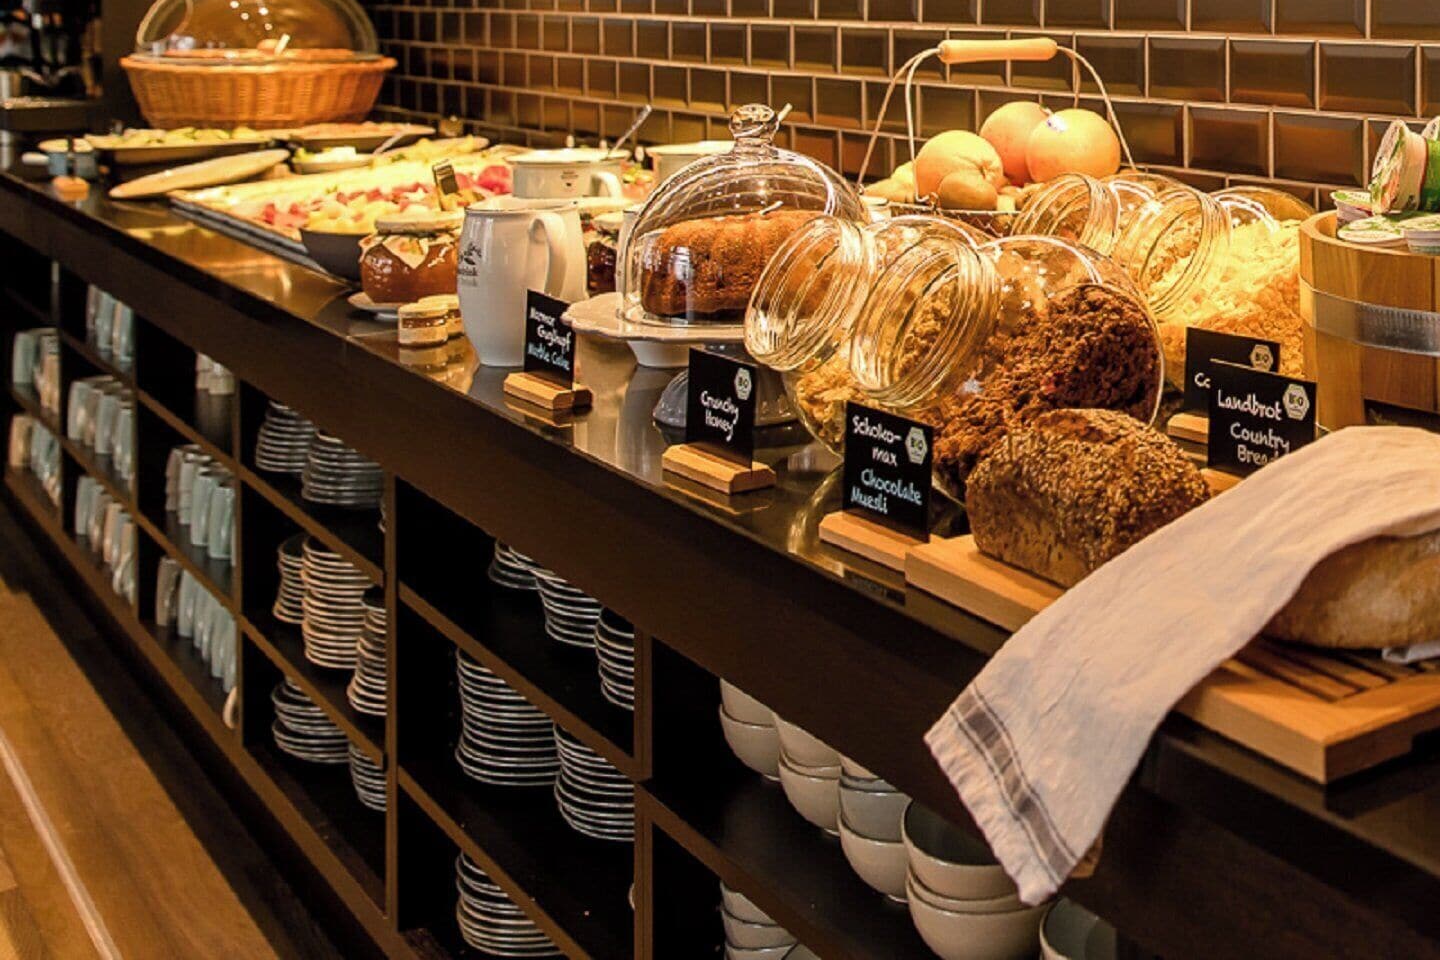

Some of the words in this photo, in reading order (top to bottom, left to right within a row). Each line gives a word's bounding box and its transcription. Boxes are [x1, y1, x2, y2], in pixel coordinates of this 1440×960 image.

[1217, 388, 1283, 421] Landbrot
[704, 410, 735, 442] Honey
[852, 414, 903, 445] Schoko-
[1229, 421, 1291, 454] Country
[851, 485, 889, 515] Muesli
[861, 468, 923, 506] Chocolate
